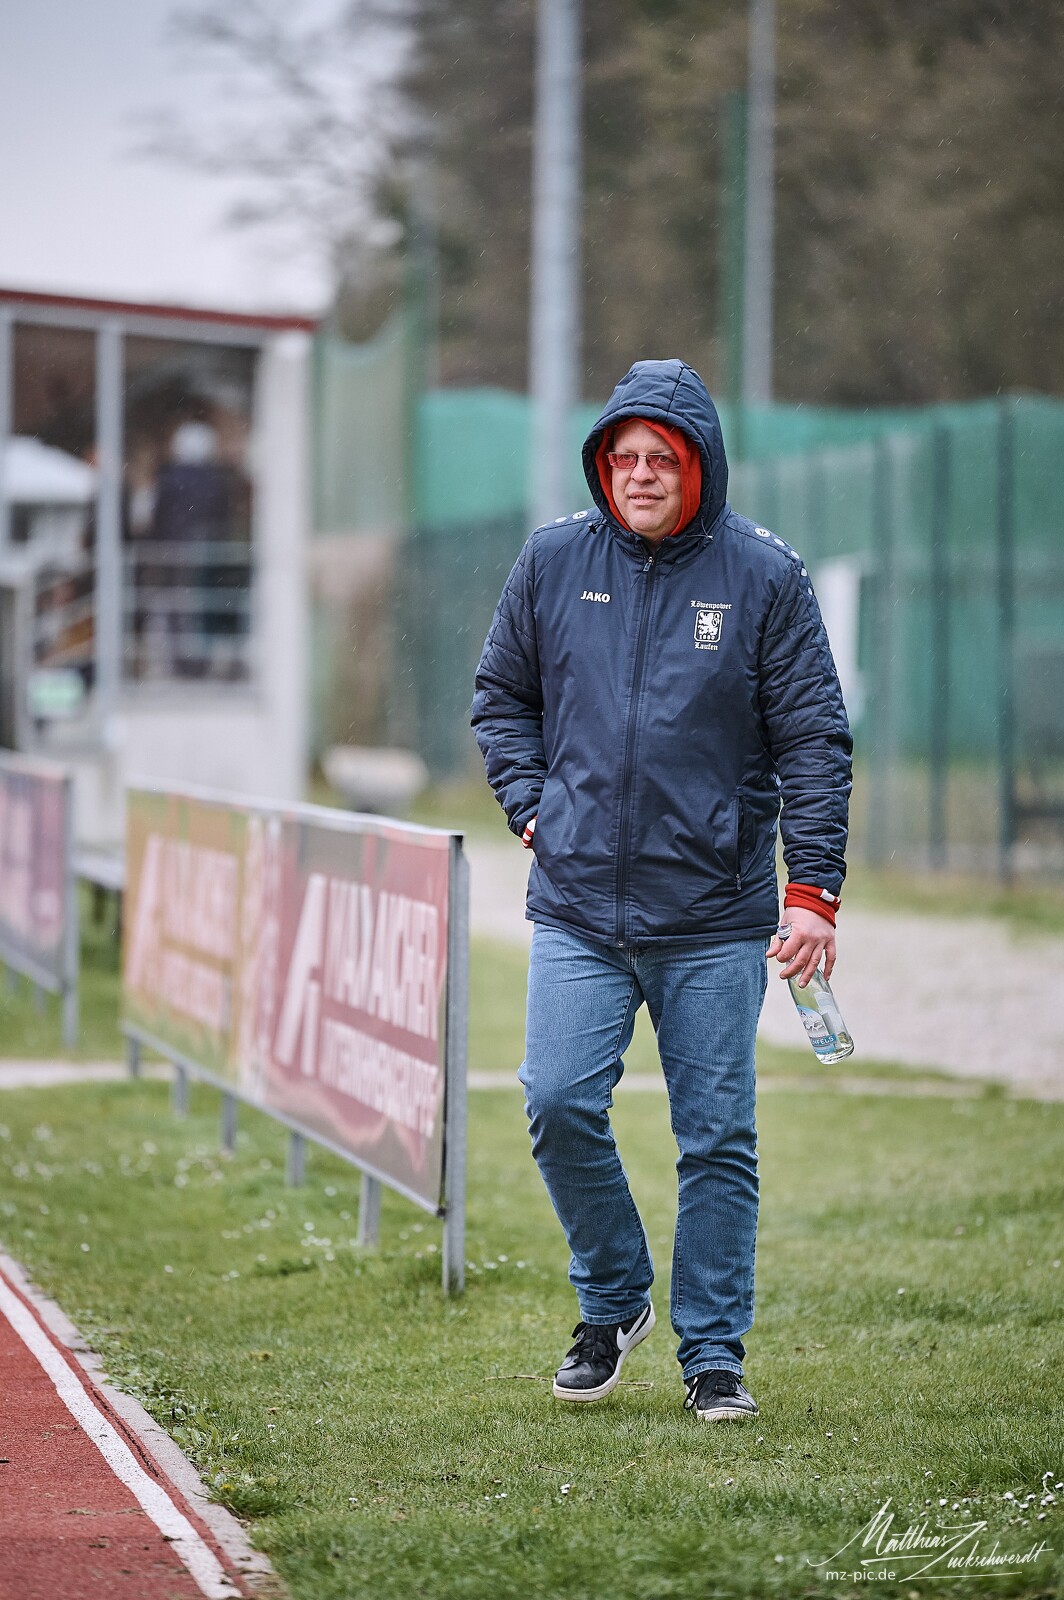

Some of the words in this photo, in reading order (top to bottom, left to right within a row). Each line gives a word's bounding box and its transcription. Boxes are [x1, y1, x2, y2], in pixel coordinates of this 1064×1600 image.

[580, 590, 611, 604] JAKO
[690, 600, 732, 610] Löwenpower
[694, 641, 719, 651] Laufen
